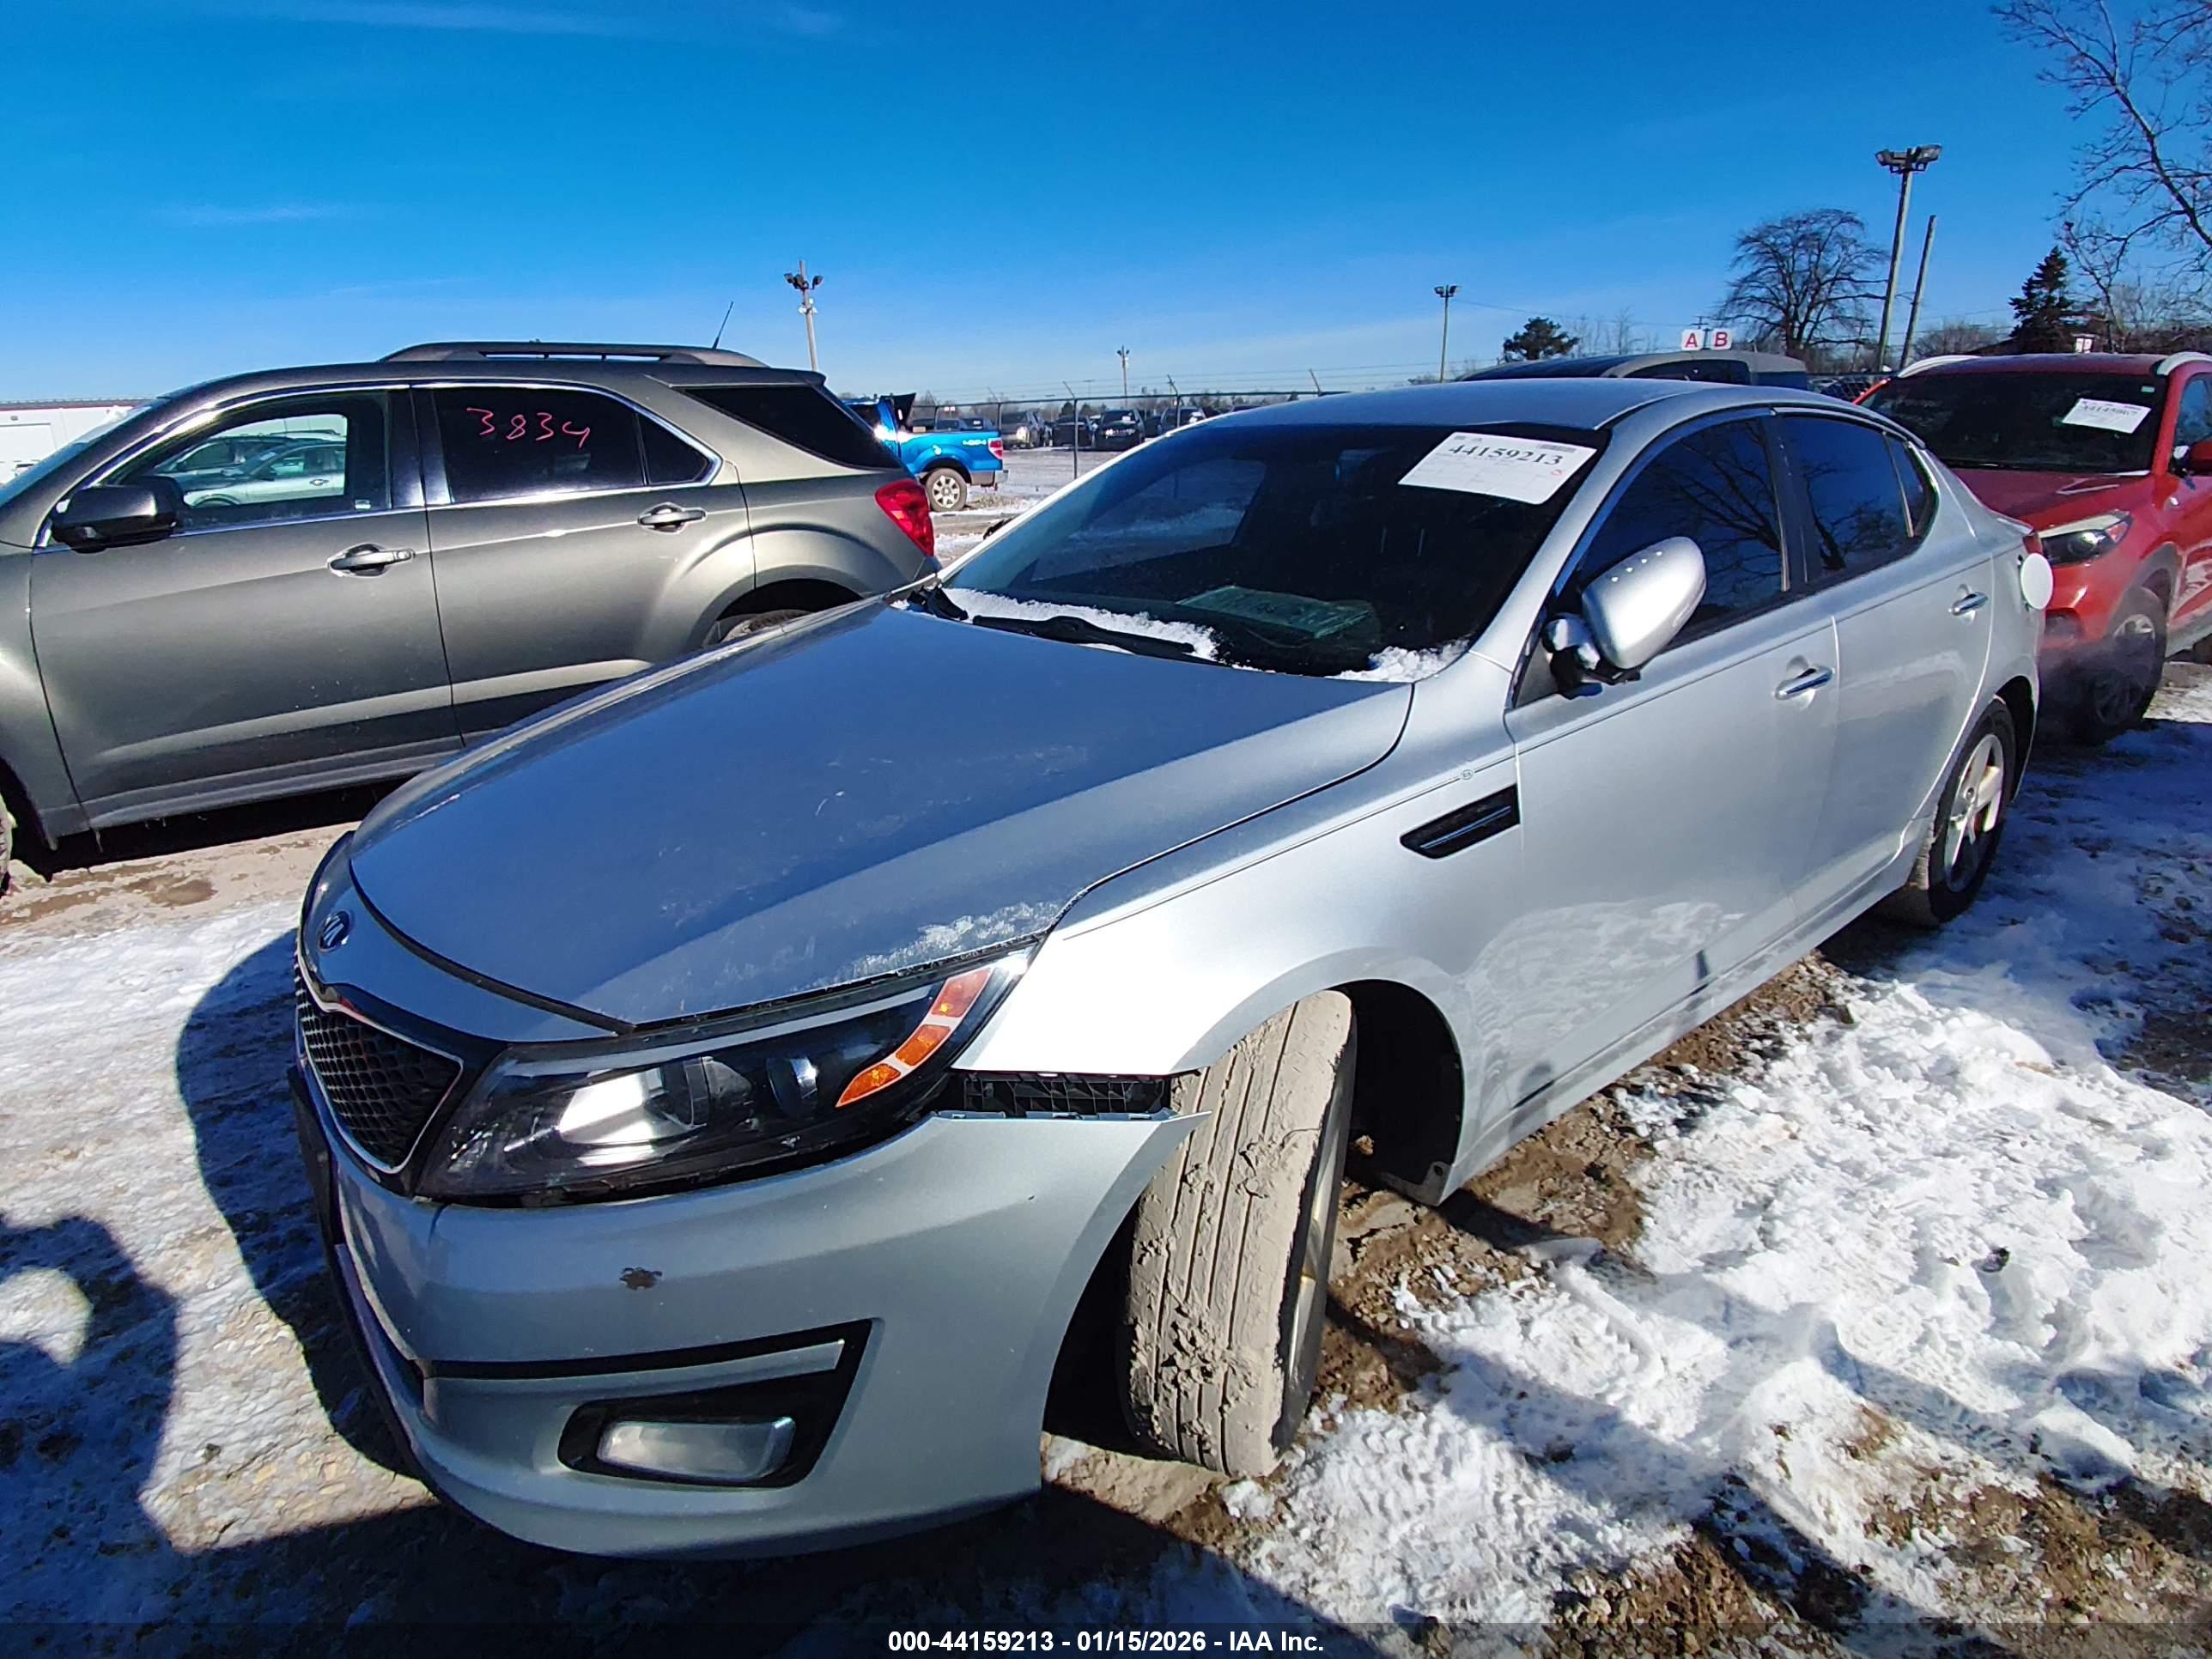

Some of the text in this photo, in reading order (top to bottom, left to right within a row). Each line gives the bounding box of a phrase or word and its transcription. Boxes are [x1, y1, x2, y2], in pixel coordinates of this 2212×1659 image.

[1685, 332, 1698, 348] A
[1714, 331, 1729, 347] B
[466, 407, 591, 448] 3834
[1448, 443, 1564, 466] 44159213
